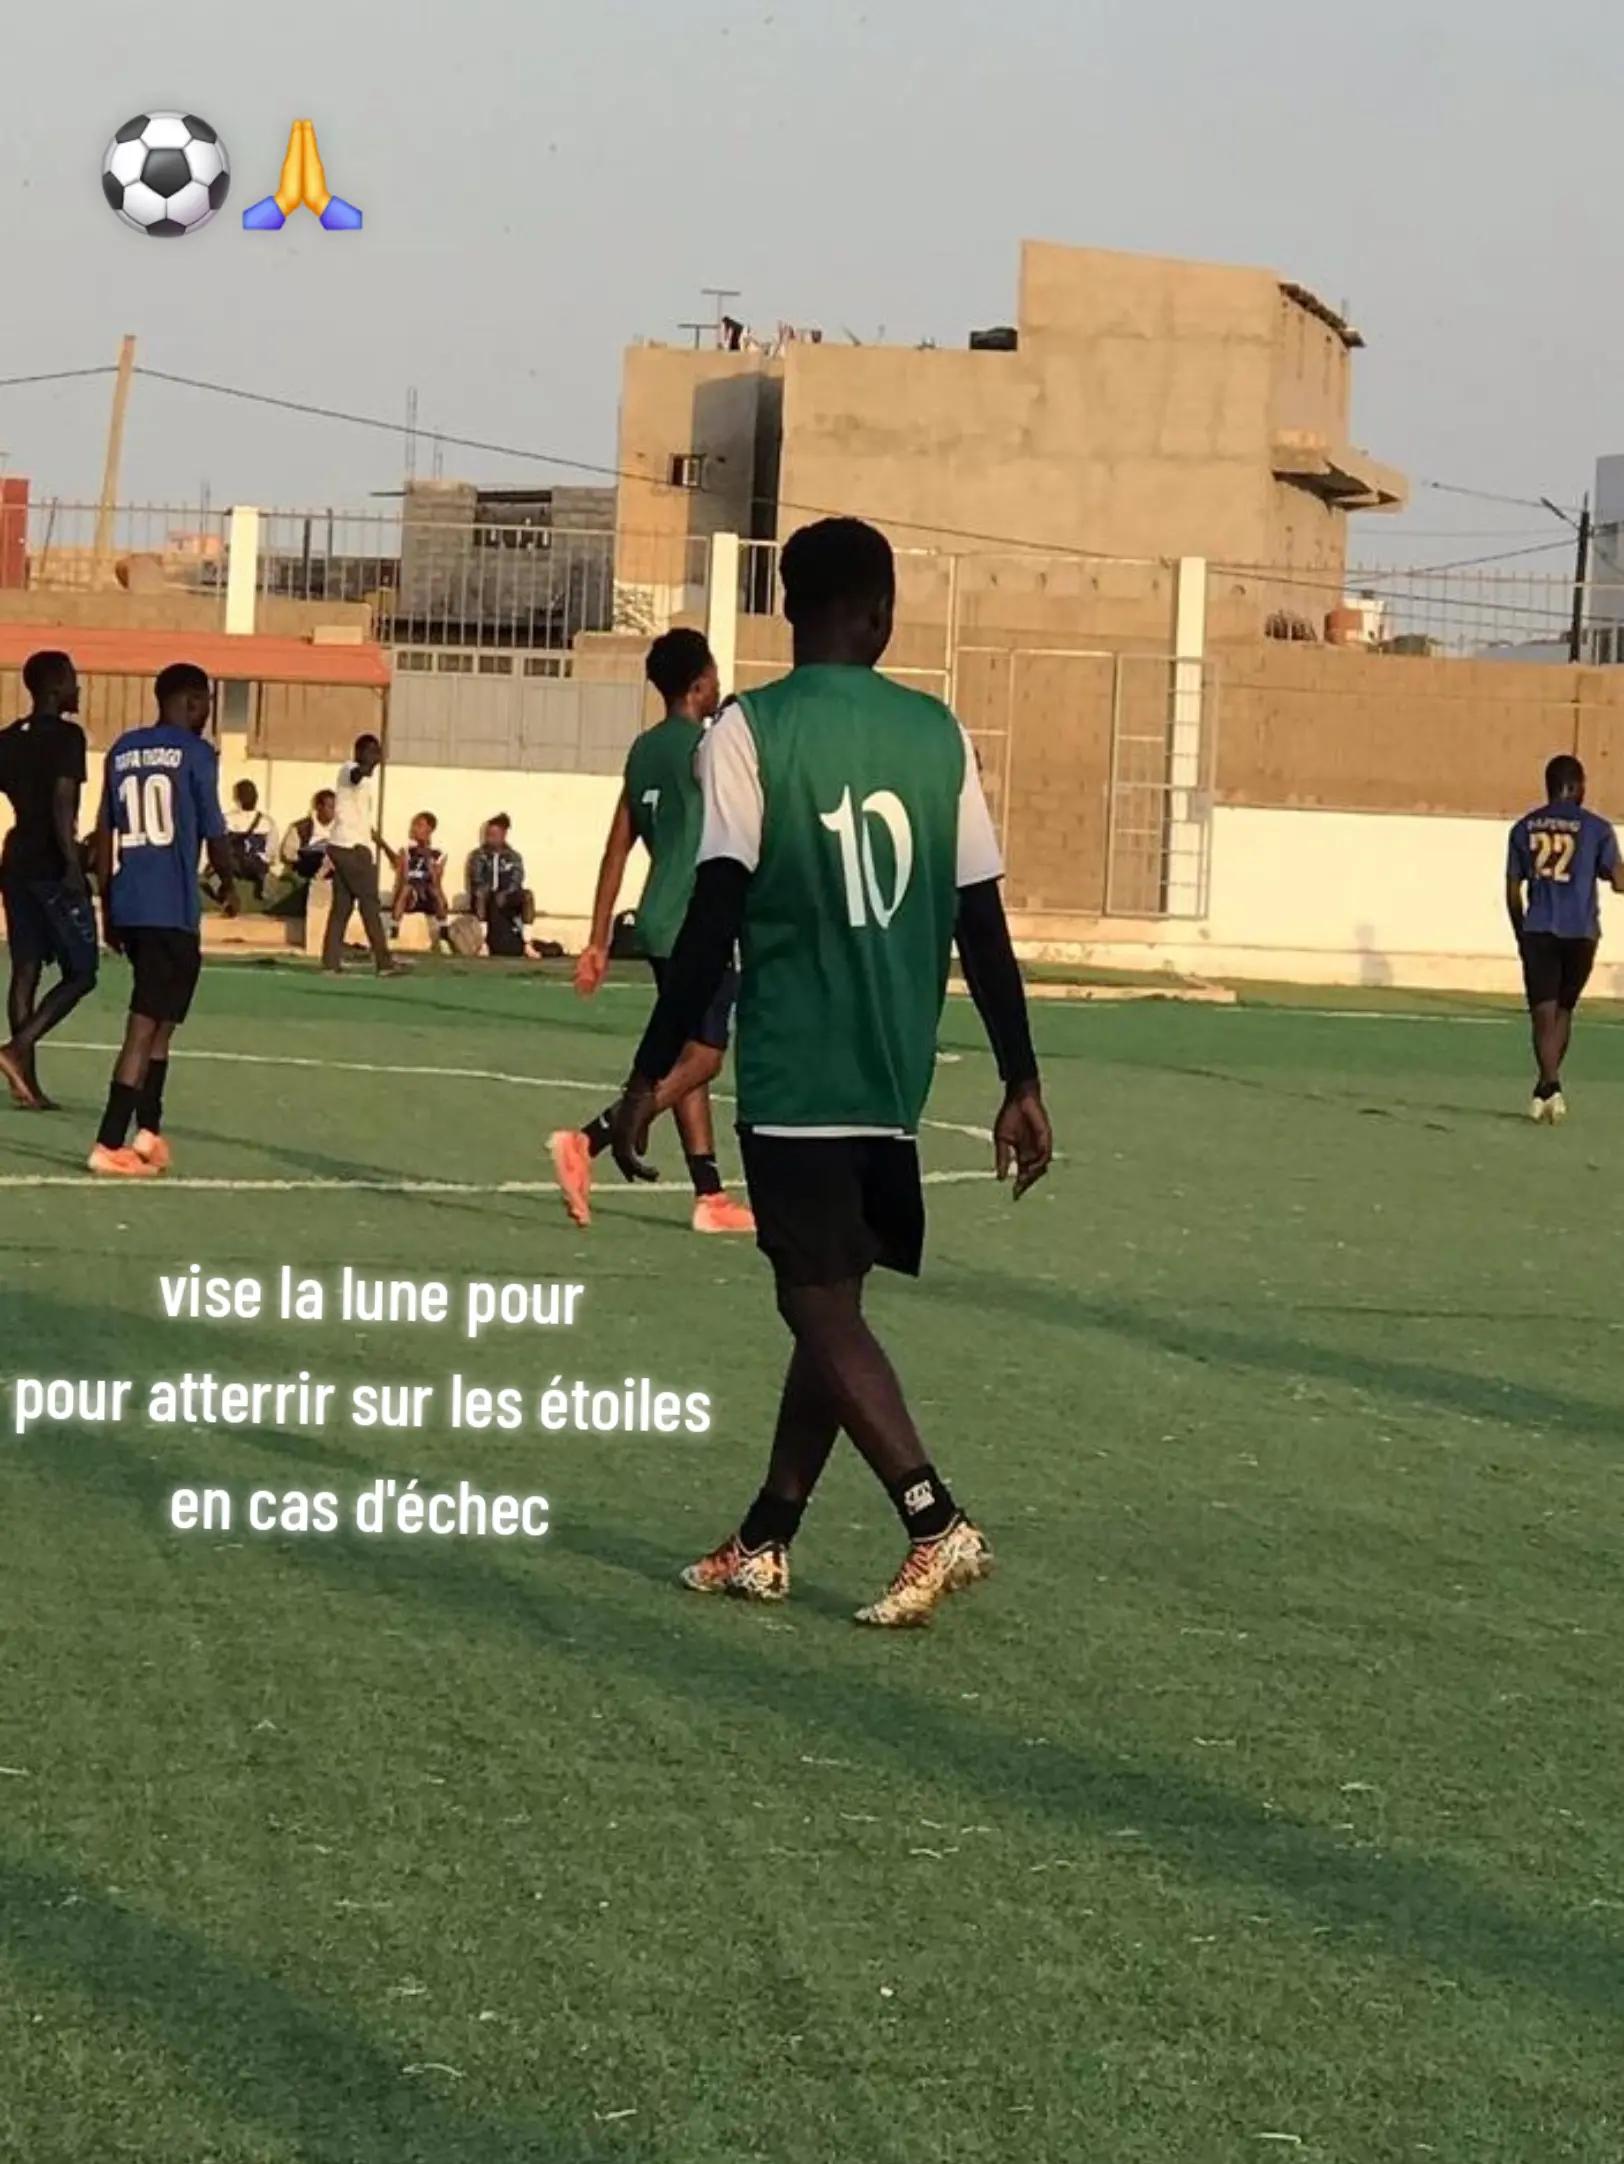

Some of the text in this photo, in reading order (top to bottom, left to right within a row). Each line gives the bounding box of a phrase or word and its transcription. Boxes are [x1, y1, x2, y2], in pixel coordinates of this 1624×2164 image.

[118, 773, 175, 848] 10
[819, 784, 914, 930] 10
[1528, 831, 1576, 883] 22
